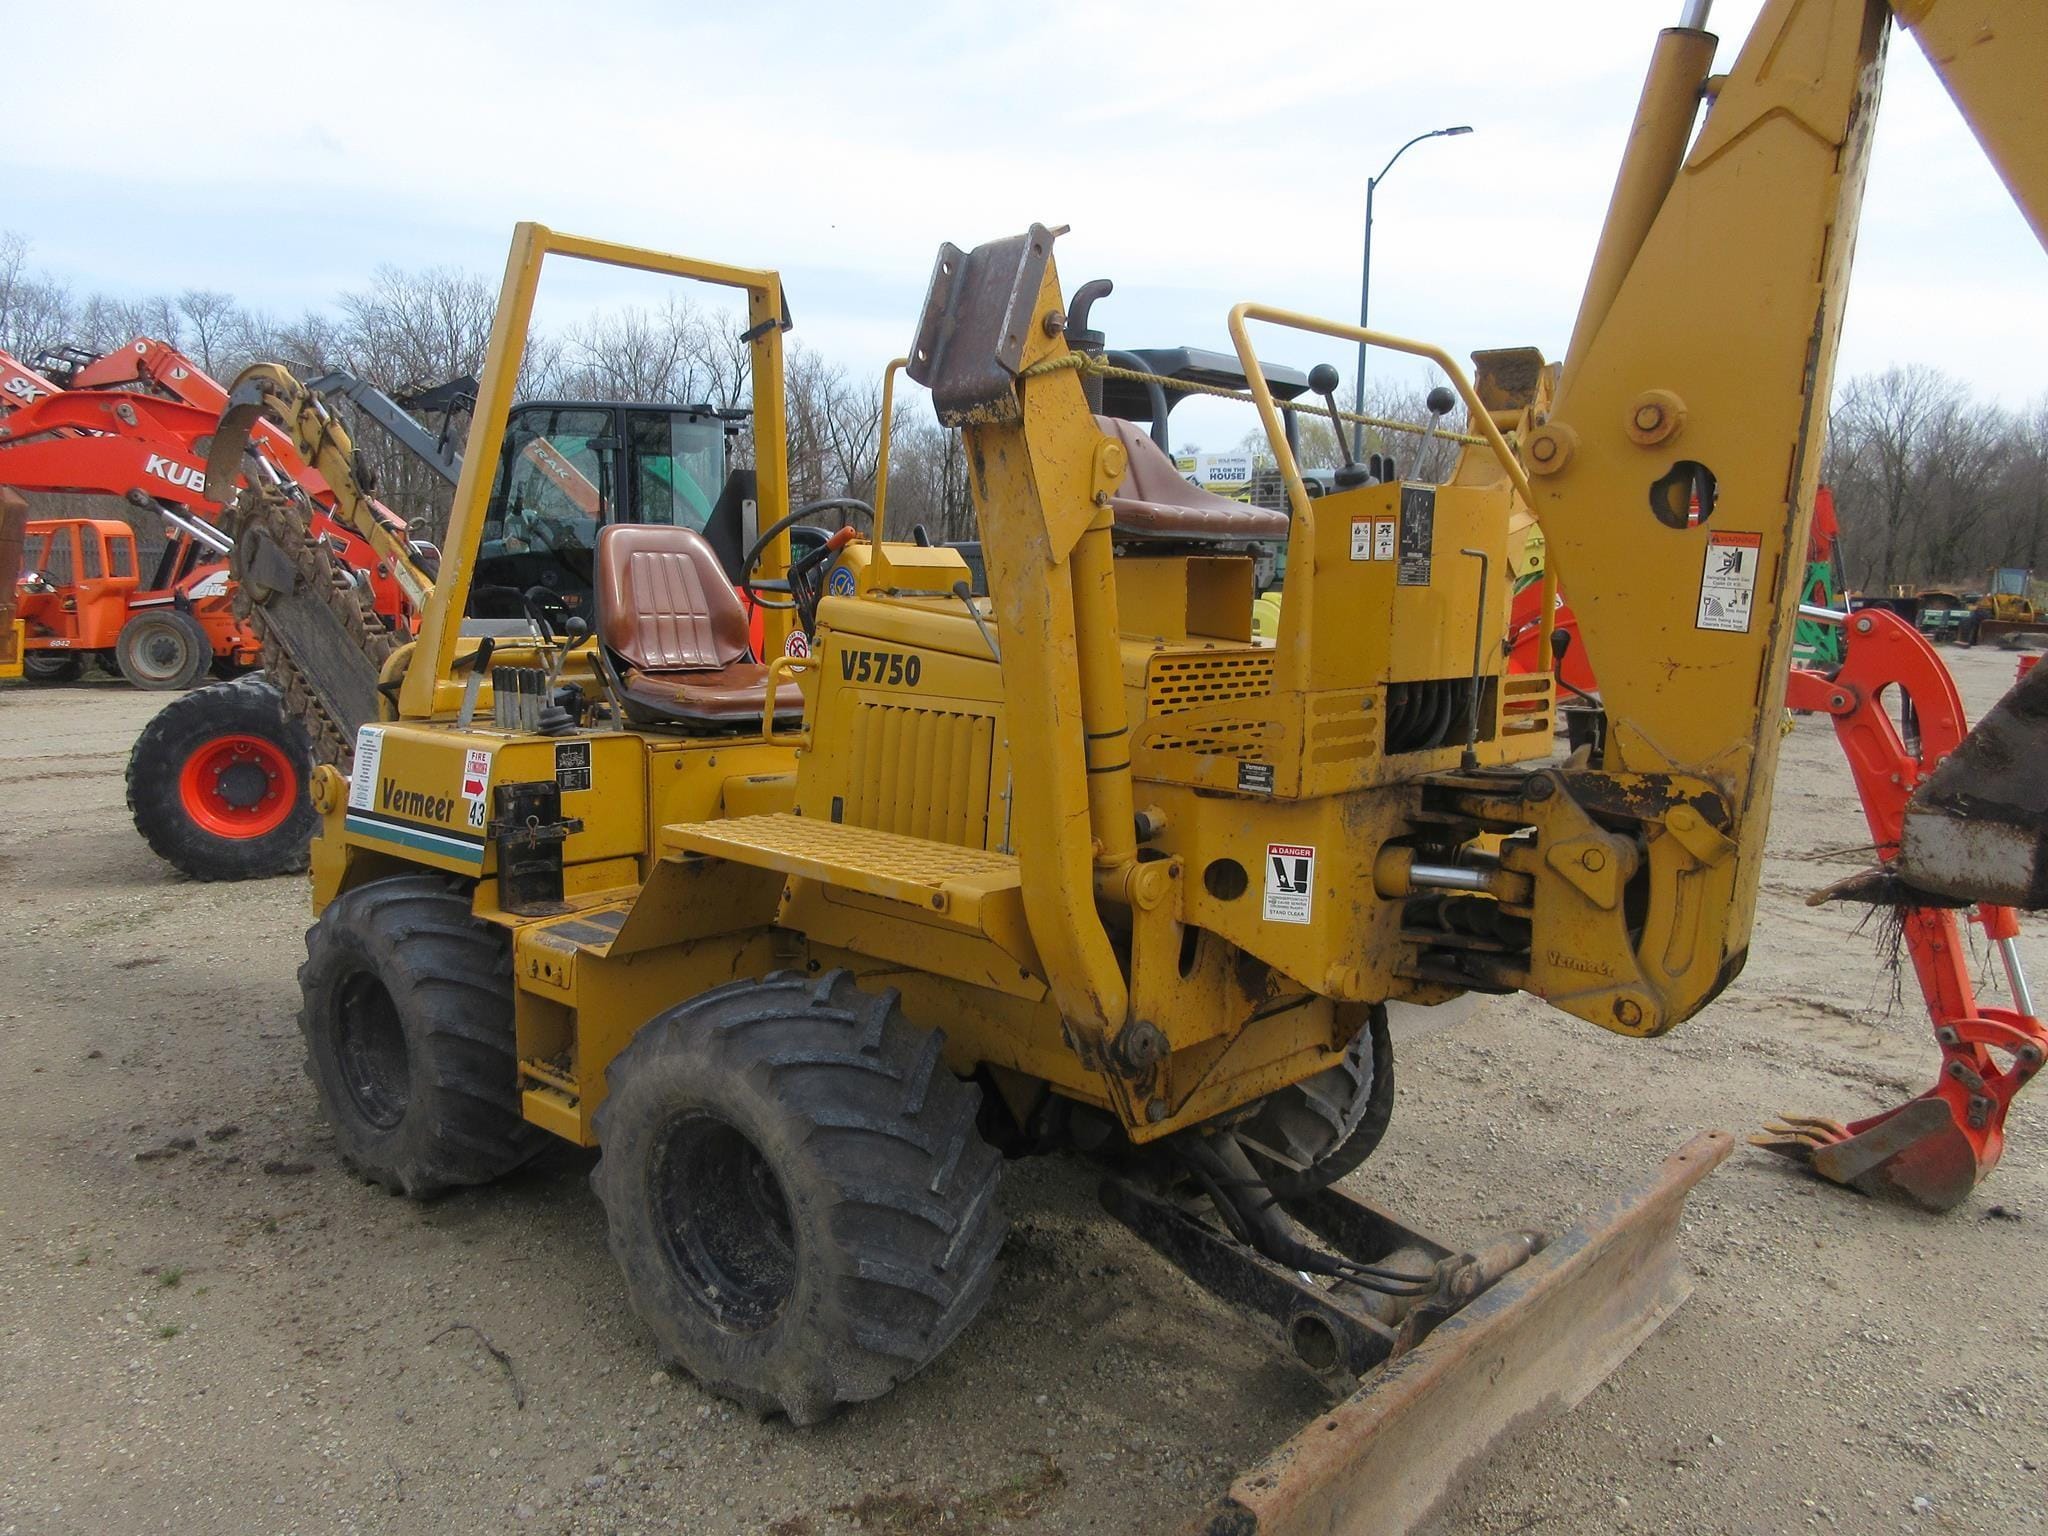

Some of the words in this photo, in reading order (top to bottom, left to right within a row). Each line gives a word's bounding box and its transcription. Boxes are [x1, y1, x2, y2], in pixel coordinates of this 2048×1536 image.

[841, 650, 921, 687] V5750
[471, 751, 486, 762] FIRE
[383, 777, 455, 823] Vermeer
[469, 801, 485, 827] 43
[1278, 847, 1311, 856] DANGER
